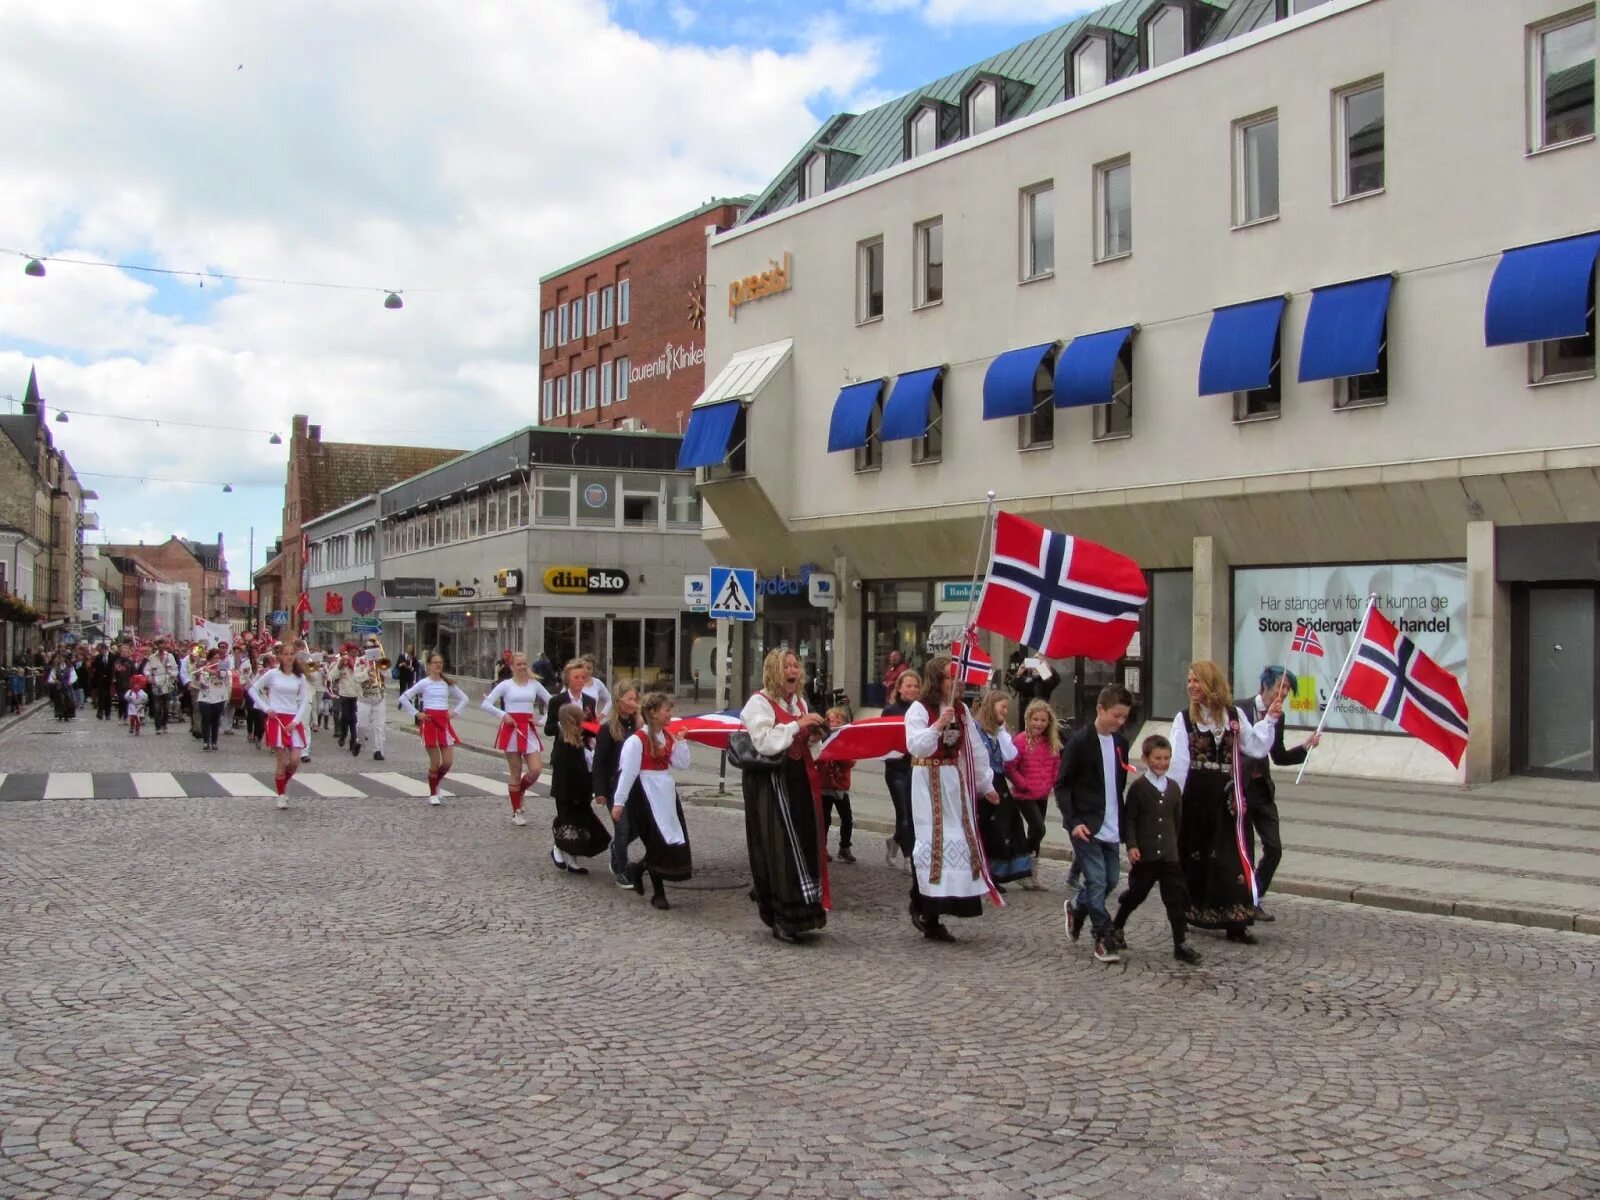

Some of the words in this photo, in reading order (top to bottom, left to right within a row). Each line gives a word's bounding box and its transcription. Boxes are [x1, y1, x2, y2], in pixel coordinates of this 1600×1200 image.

[552, 571, 624, 589] dinsko
[442, 588, 474, 597] dinsko
[1260, 596, 1281, 610] Här
[1284, 596, 1330, 613] stänger
[1333, 595, 1342, 609] vi
[1345, 594, 1363, 609] för
[1386, 594, 1427, 610] kunna
[1431, 596, 1448, 613] ge
[1258, 617, 1292, 632] Stora
[1400, 616, 1450, 633] handel
